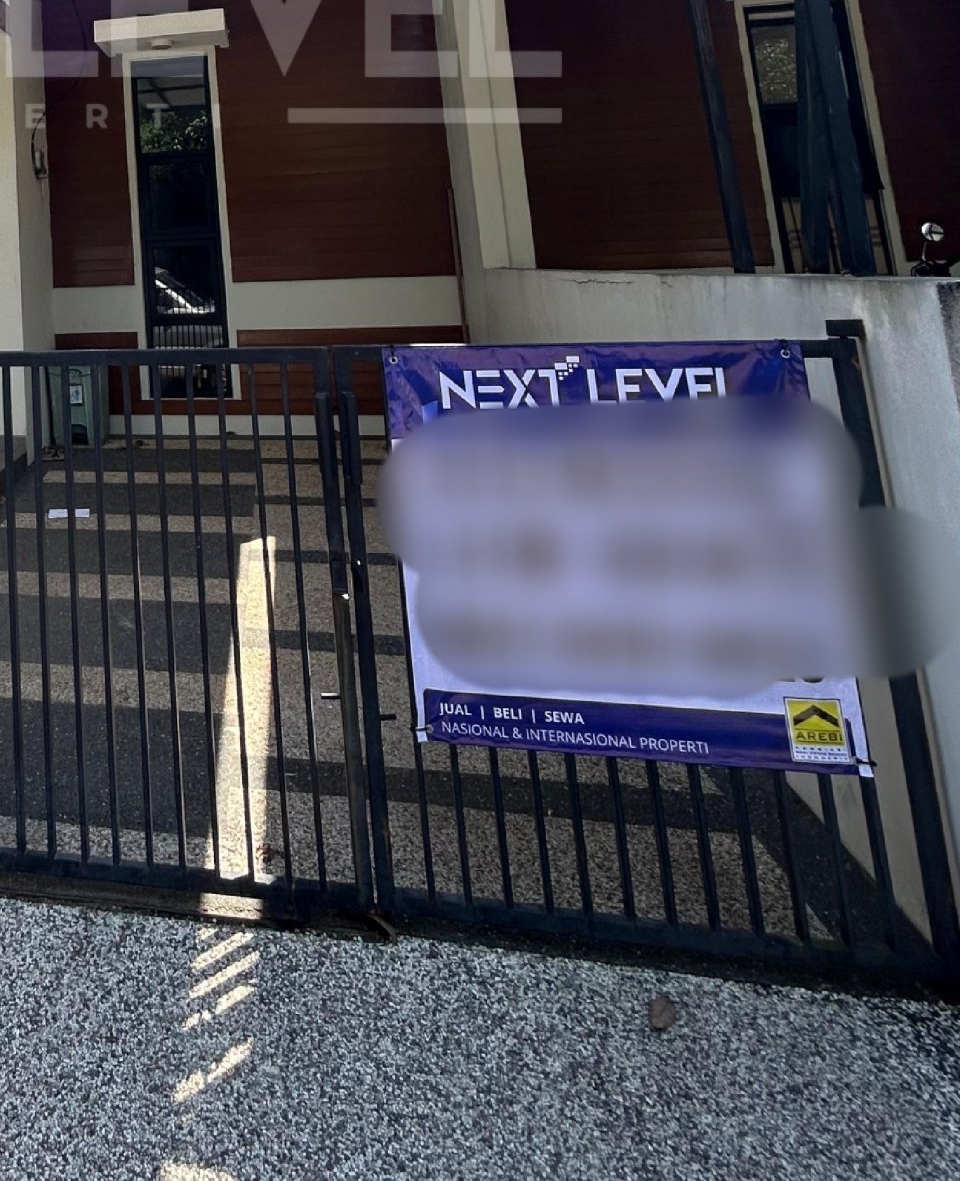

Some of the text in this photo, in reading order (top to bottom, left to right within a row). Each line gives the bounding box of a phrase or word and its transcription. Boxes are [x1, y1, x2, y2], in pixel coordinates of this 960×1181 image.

[439, 366, 568, 410] NEXT
[439, 702, 473, 717] JUAL
[493, 706, 523, 720] BELI
[544, 710, 585, 725] SEWA
[441, 721, 710, 755] NASIONAL & INTERNASIONAL PROPERTI
[795, 731, 843, 742] AREBI
